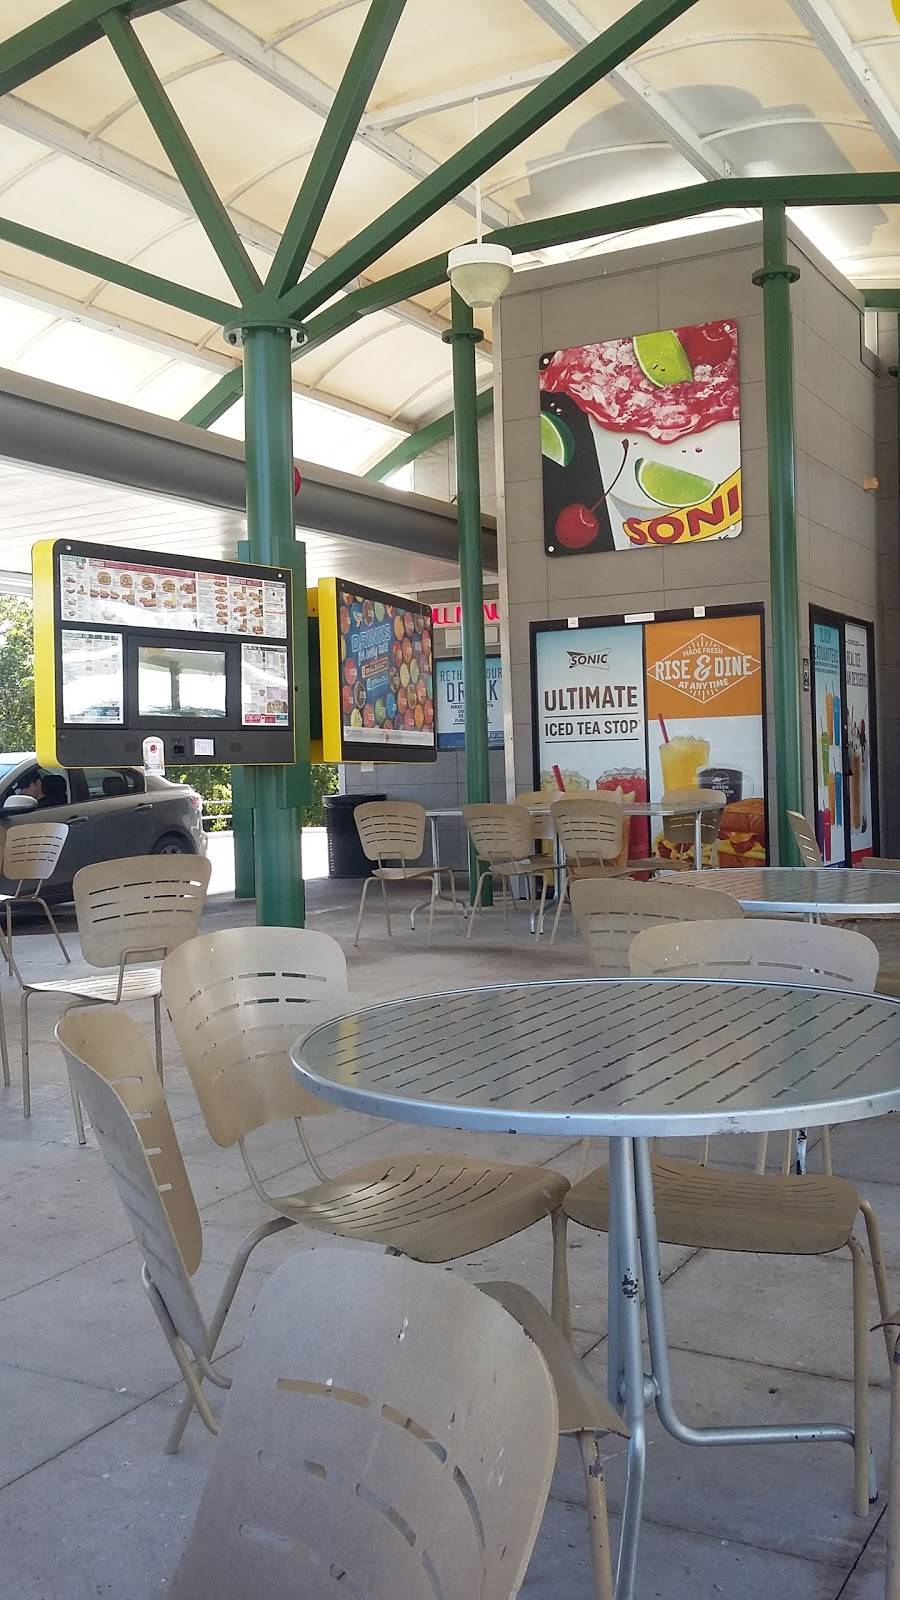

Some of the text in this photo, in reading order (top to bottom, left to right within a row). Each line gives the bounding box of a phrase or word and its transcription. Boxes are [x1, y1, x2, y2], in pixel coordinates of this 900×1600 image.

[683, 647, 724, 657] MADE FRESH
[570, 654, 608, 666] SONIC
[655, 654, 753, 682] RISE & DINE
[441, 670, 463, 682] RETH
[447, 679, 499, 703] DRK
[677, 681, 689, 689] AT
[544, 685, 638, 712] ULTIMATE
[545, 719, 638, 737] ICED TEA STOP
